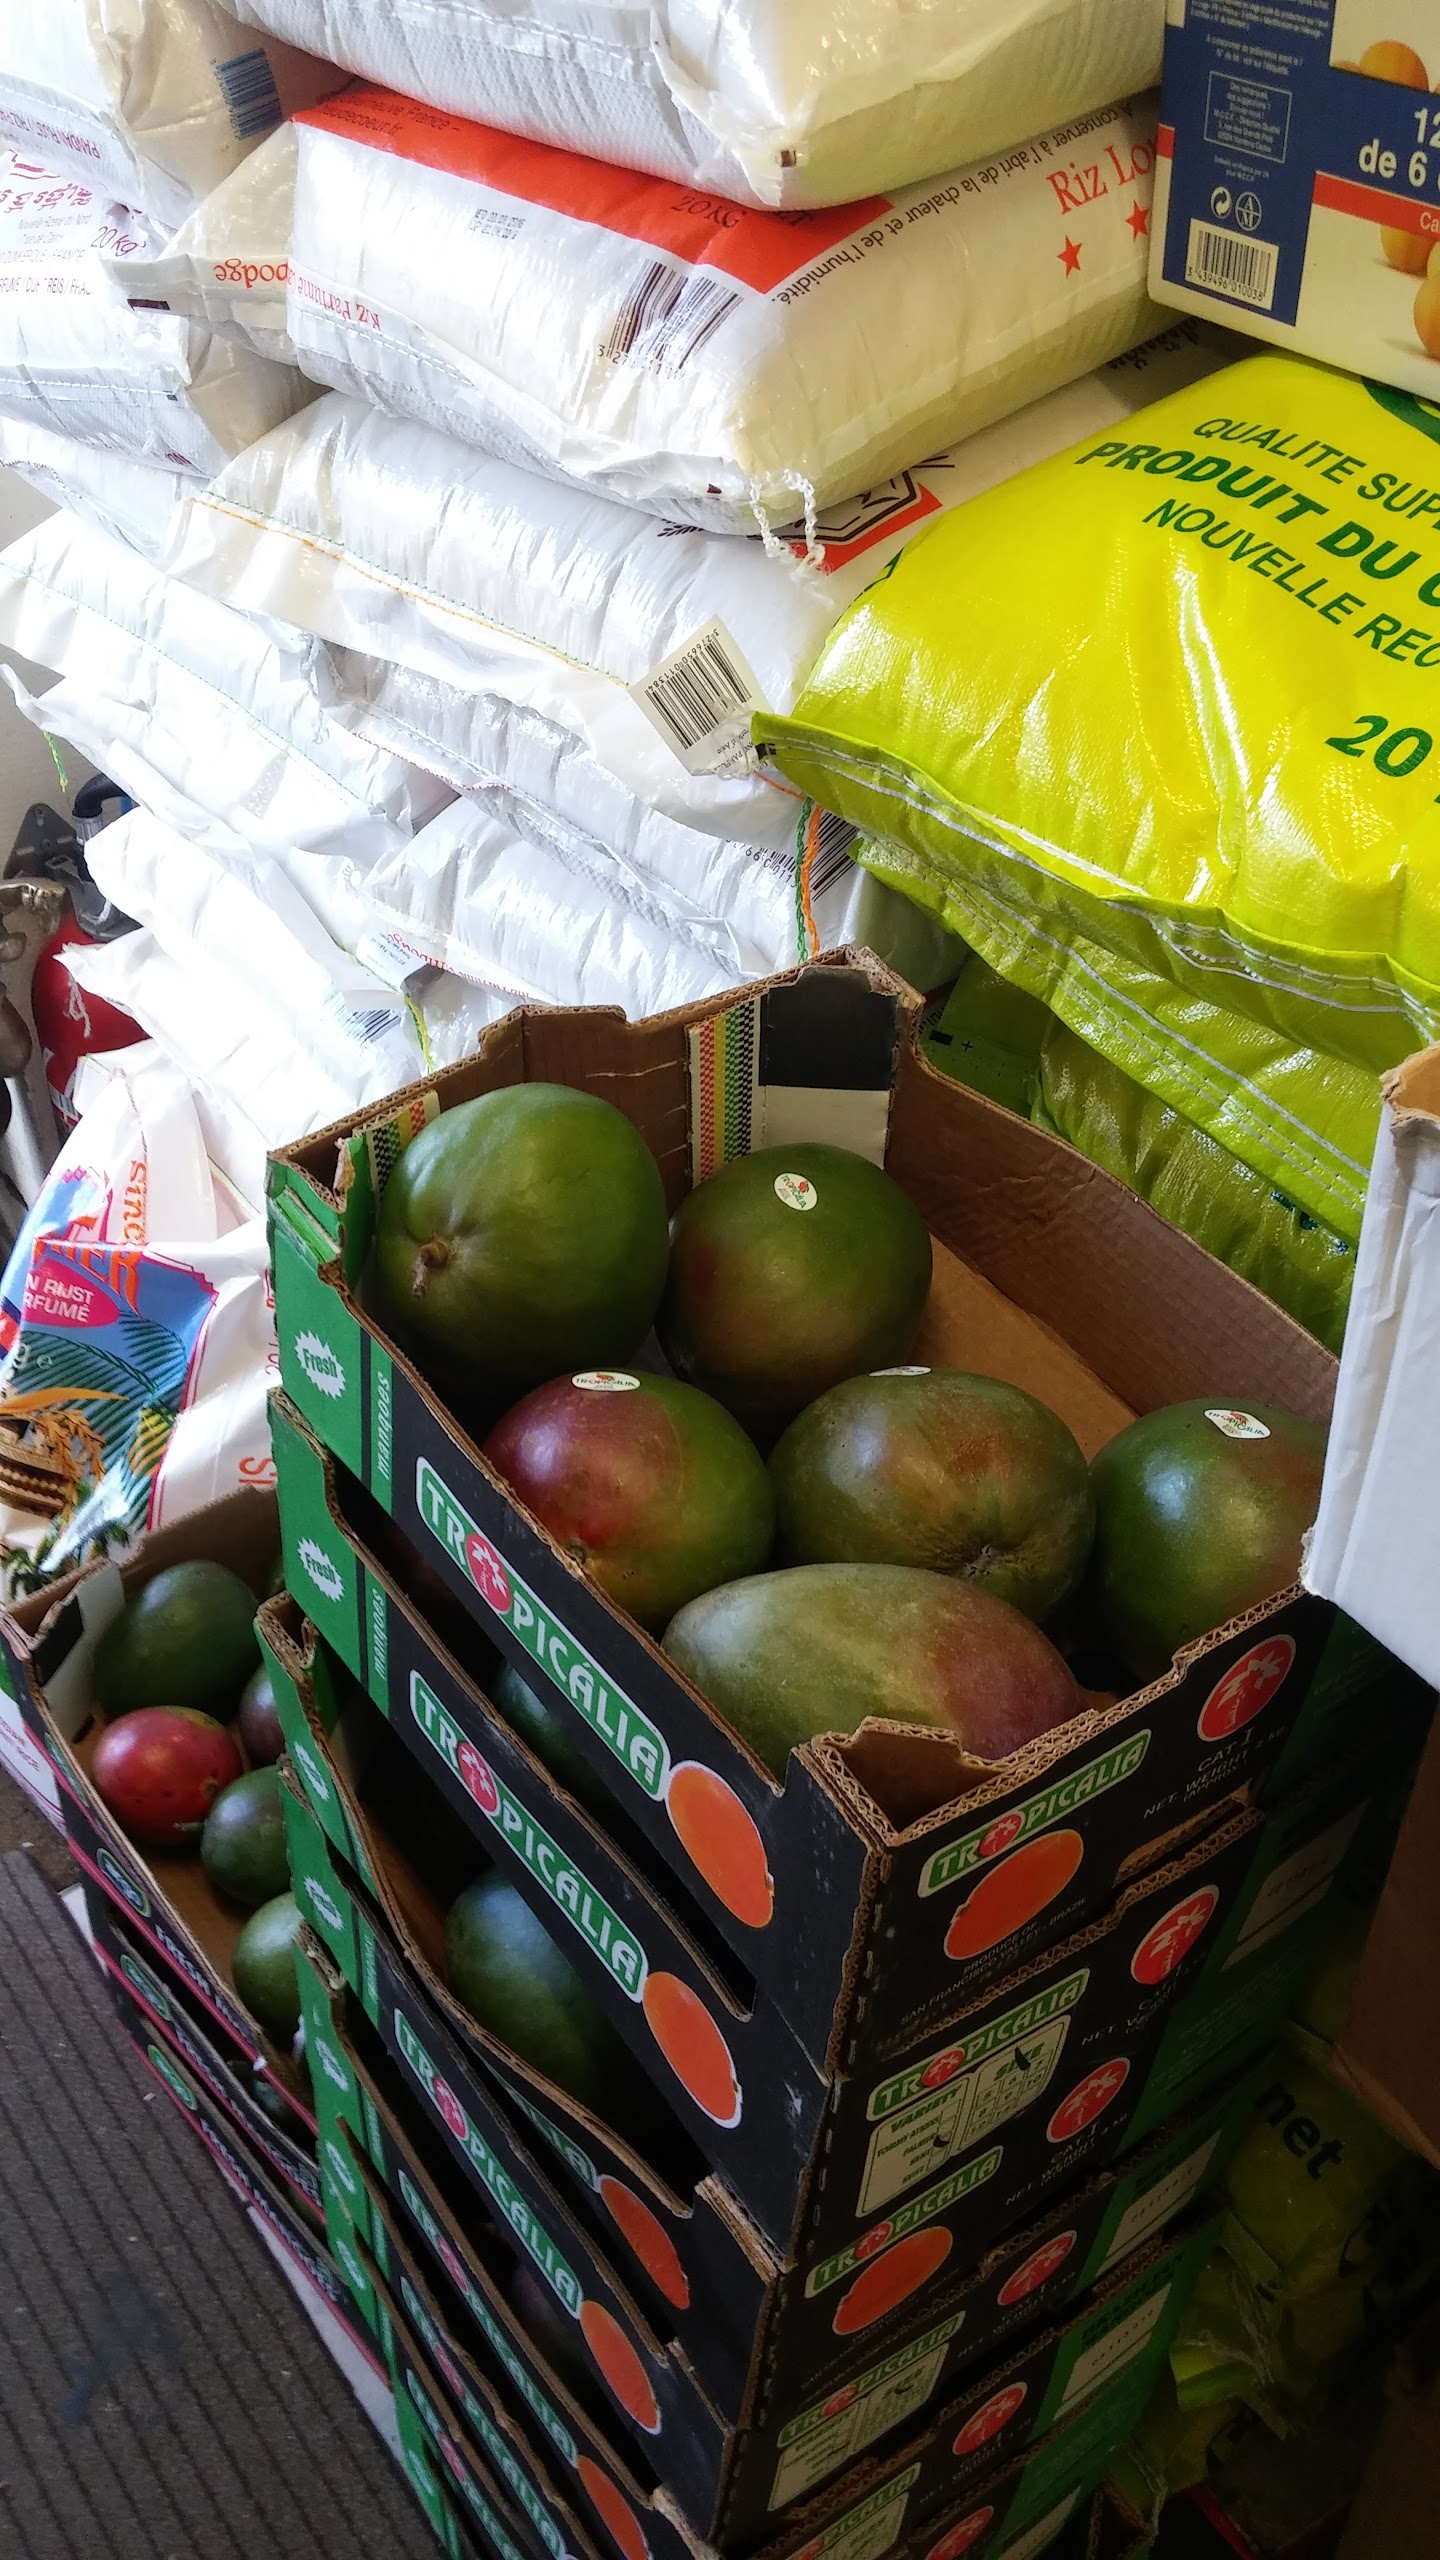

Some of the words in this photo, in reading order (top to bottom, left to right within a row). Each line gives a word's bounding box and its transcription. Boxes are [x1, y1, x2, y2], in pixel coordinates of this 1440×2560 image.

[1054, 108, 1118, 147] conserver
[977, 168, 999, 185] de
[1045, 161, 1109, 215] Riz
[1104, 144, 1157, 186] Lo
[1358, 138, 1397, 179] de
[1408, 151, 1428, 187] 6
[905, 186, 961, 223] chaleur
[961, 178, 981, 193] la
[860, 229, 884, 246] de
[884, 217, 904, 235] et
[1193, 418, 1367, 485] QUALITE
[1358, 472, 1440, 531] SUP
[1075, 442, 1330, 524] PRODUIT
[1316, 520, 1422, 580] DU
[1142, 498, 1368, 626] NOUVELLE
[1325, 714, 1433, 779] 20
[43, 1278, 95, 1306] RIJST
[302, 1346, 339, 1380] Fresh
[376, 1371, 391, 1482] mangoes
[304, 1551, 338, 1586] Fresh
[1198, 1740, 1238, 1772] CAT
[1256, 2082, 1344, 2182] net
